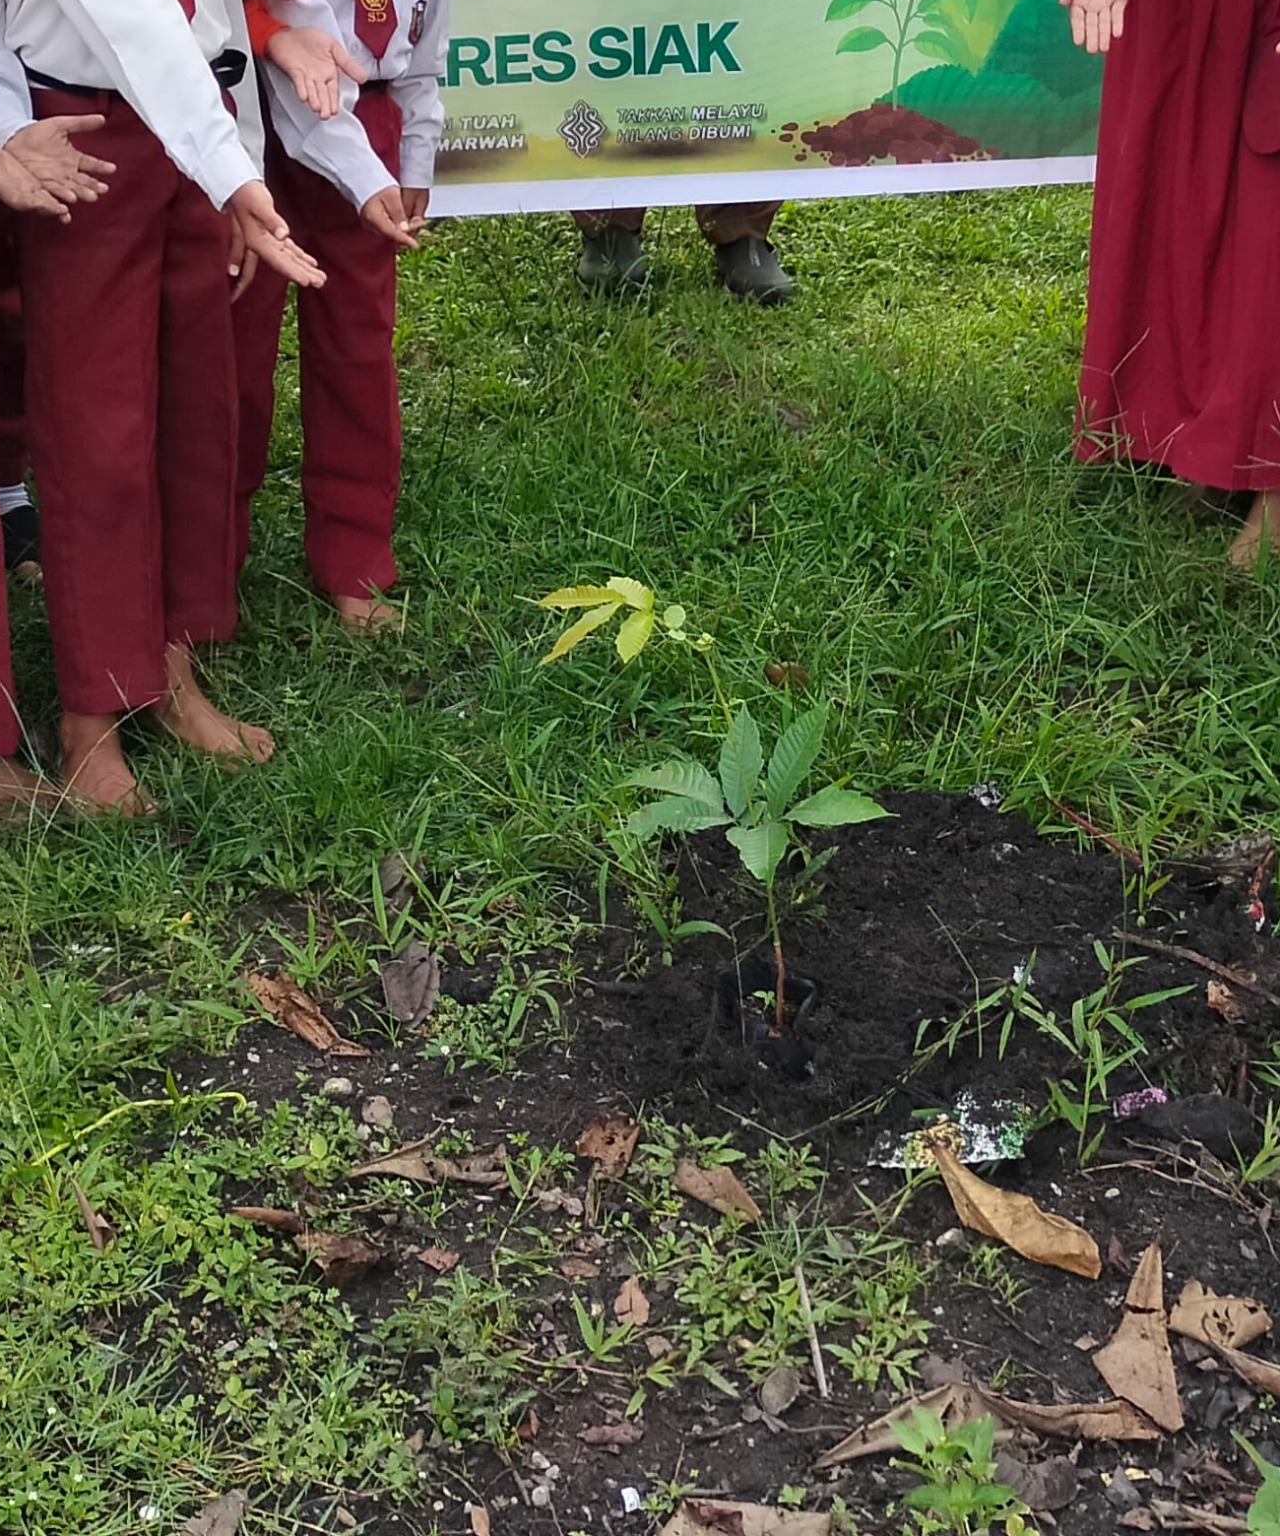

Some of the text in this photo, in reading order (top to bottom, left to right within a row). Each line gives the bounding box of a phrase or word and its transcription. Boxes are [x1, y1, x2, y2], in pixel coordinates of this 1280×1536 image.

[367, 11, 388, 23] SD
[587, 21, 742, 80] SIAK
[461, 113, 516, 131] TUAH
[616, 103, 765, 124] TAKKAN MELAYU
[435, 133, 525, 153] MARWAH
[616, 123, 752, 144] HILANG DIBUMI
